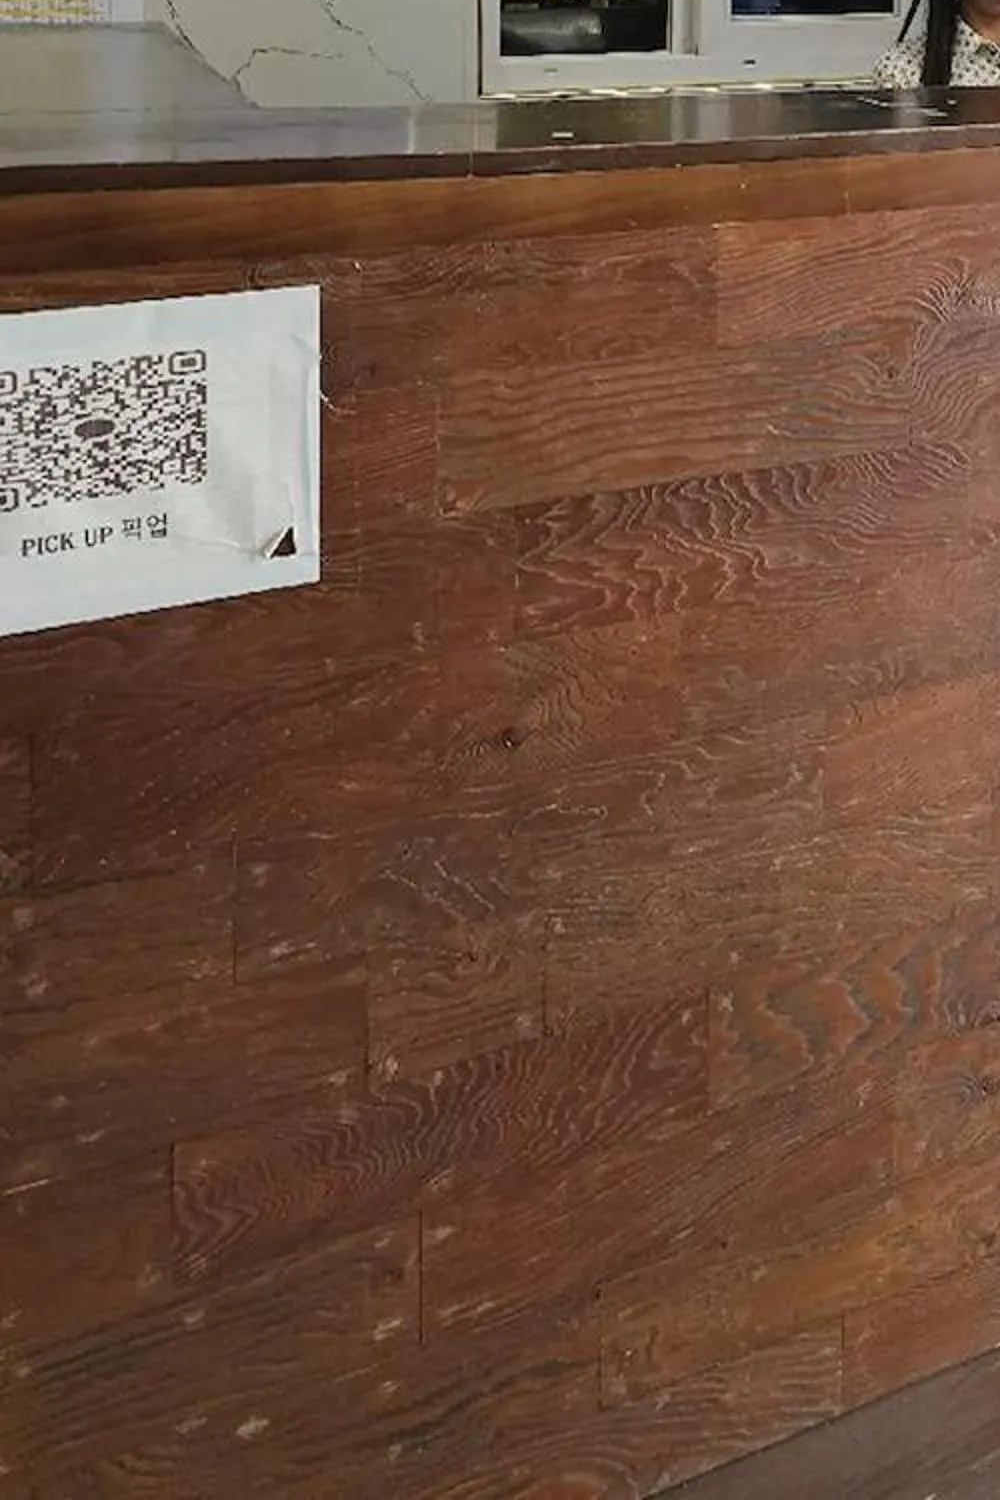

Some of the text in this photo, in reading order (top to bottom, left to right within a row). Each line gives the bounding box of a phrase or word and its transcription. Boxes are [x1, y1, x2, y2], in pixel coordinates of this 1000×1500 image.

[22, 512, 168, 557] PICK UP 픽업
